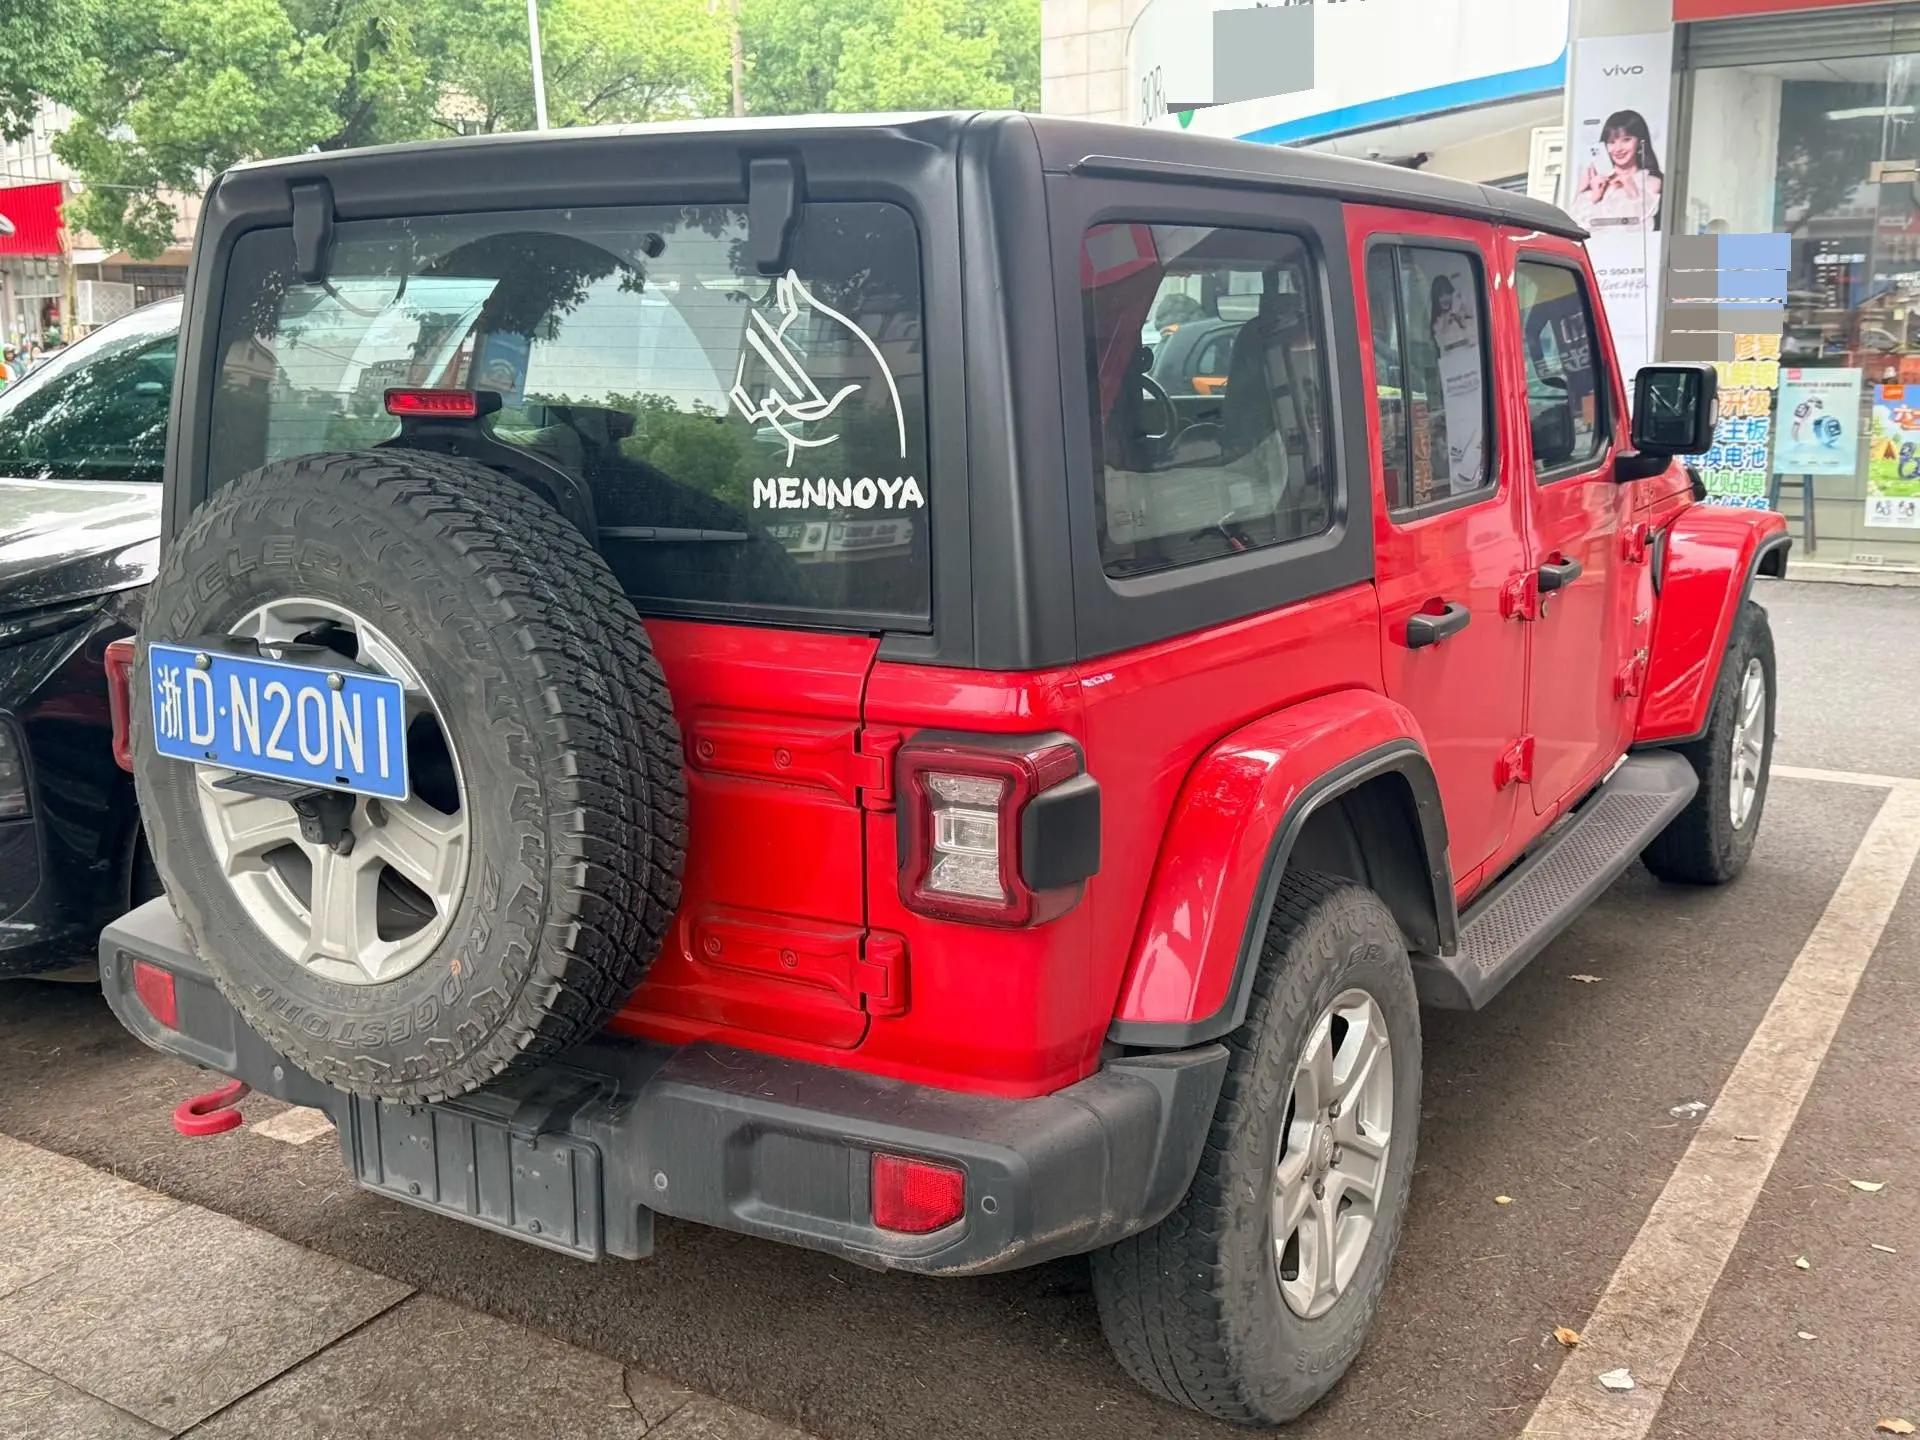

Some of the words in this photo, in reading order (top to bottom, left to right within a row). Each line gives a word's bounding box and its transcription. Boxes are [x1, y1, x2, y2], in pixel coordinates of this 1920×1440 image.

[1602, 64, 1643, 76] vivo
[753, 475, 925, 509] MENNOYA
[162, 534, 342, 642] UELER
